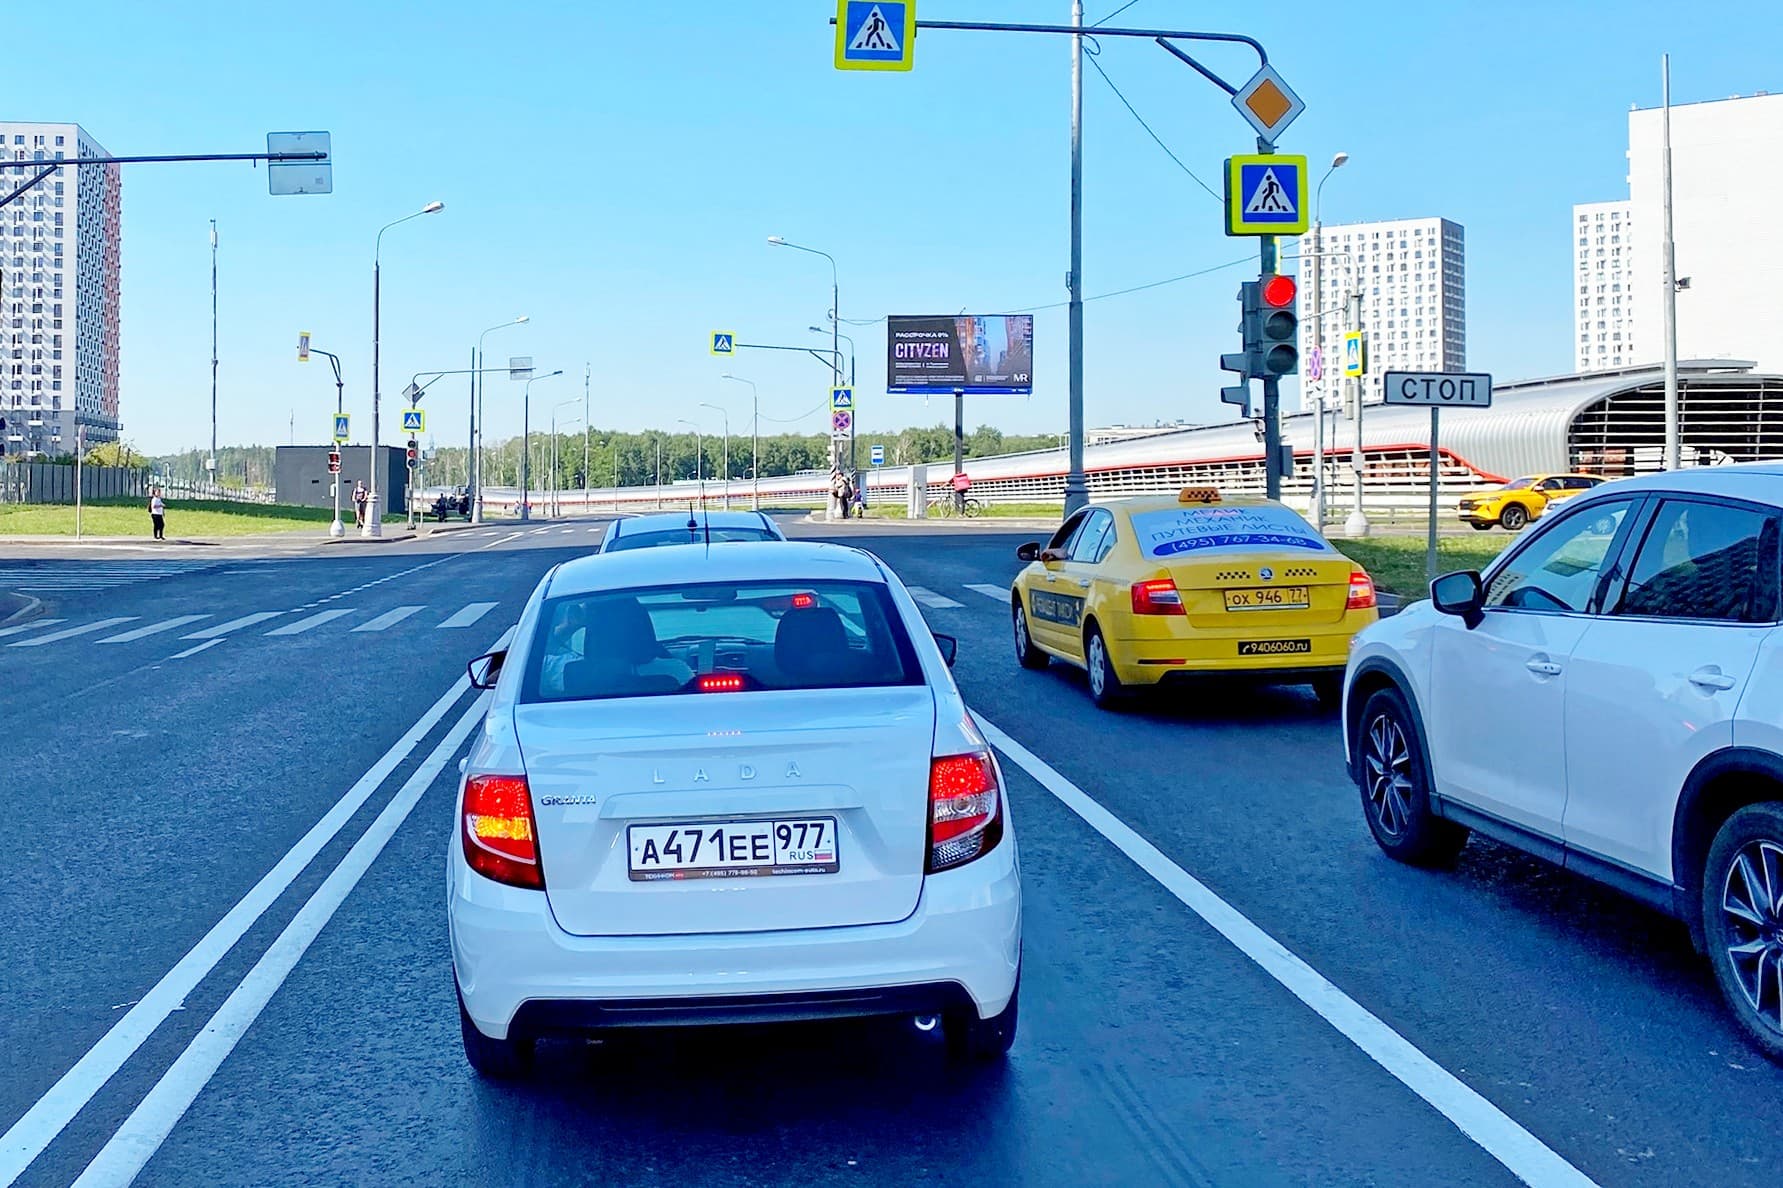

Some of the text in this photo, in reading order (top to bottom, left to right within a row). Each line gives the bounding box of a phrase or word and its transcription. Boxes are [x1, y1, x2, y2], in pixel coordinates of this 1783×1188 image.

[1401, 378, 1475, 401] СТОП
[1152, 523, 1234, 541] ПУТЕВЫЕ
[1172, 537, 1216, 552] (495)
[1255, 590, 1282, 604] 946
[1289, 588, 1302, 598] 77
[1250, 641, 1308, 653] 9406060.ru
[652, 761, 800, 785] LADA
[776, 823, 825, 850] 977
[789, 850, 814, 861] RUS
